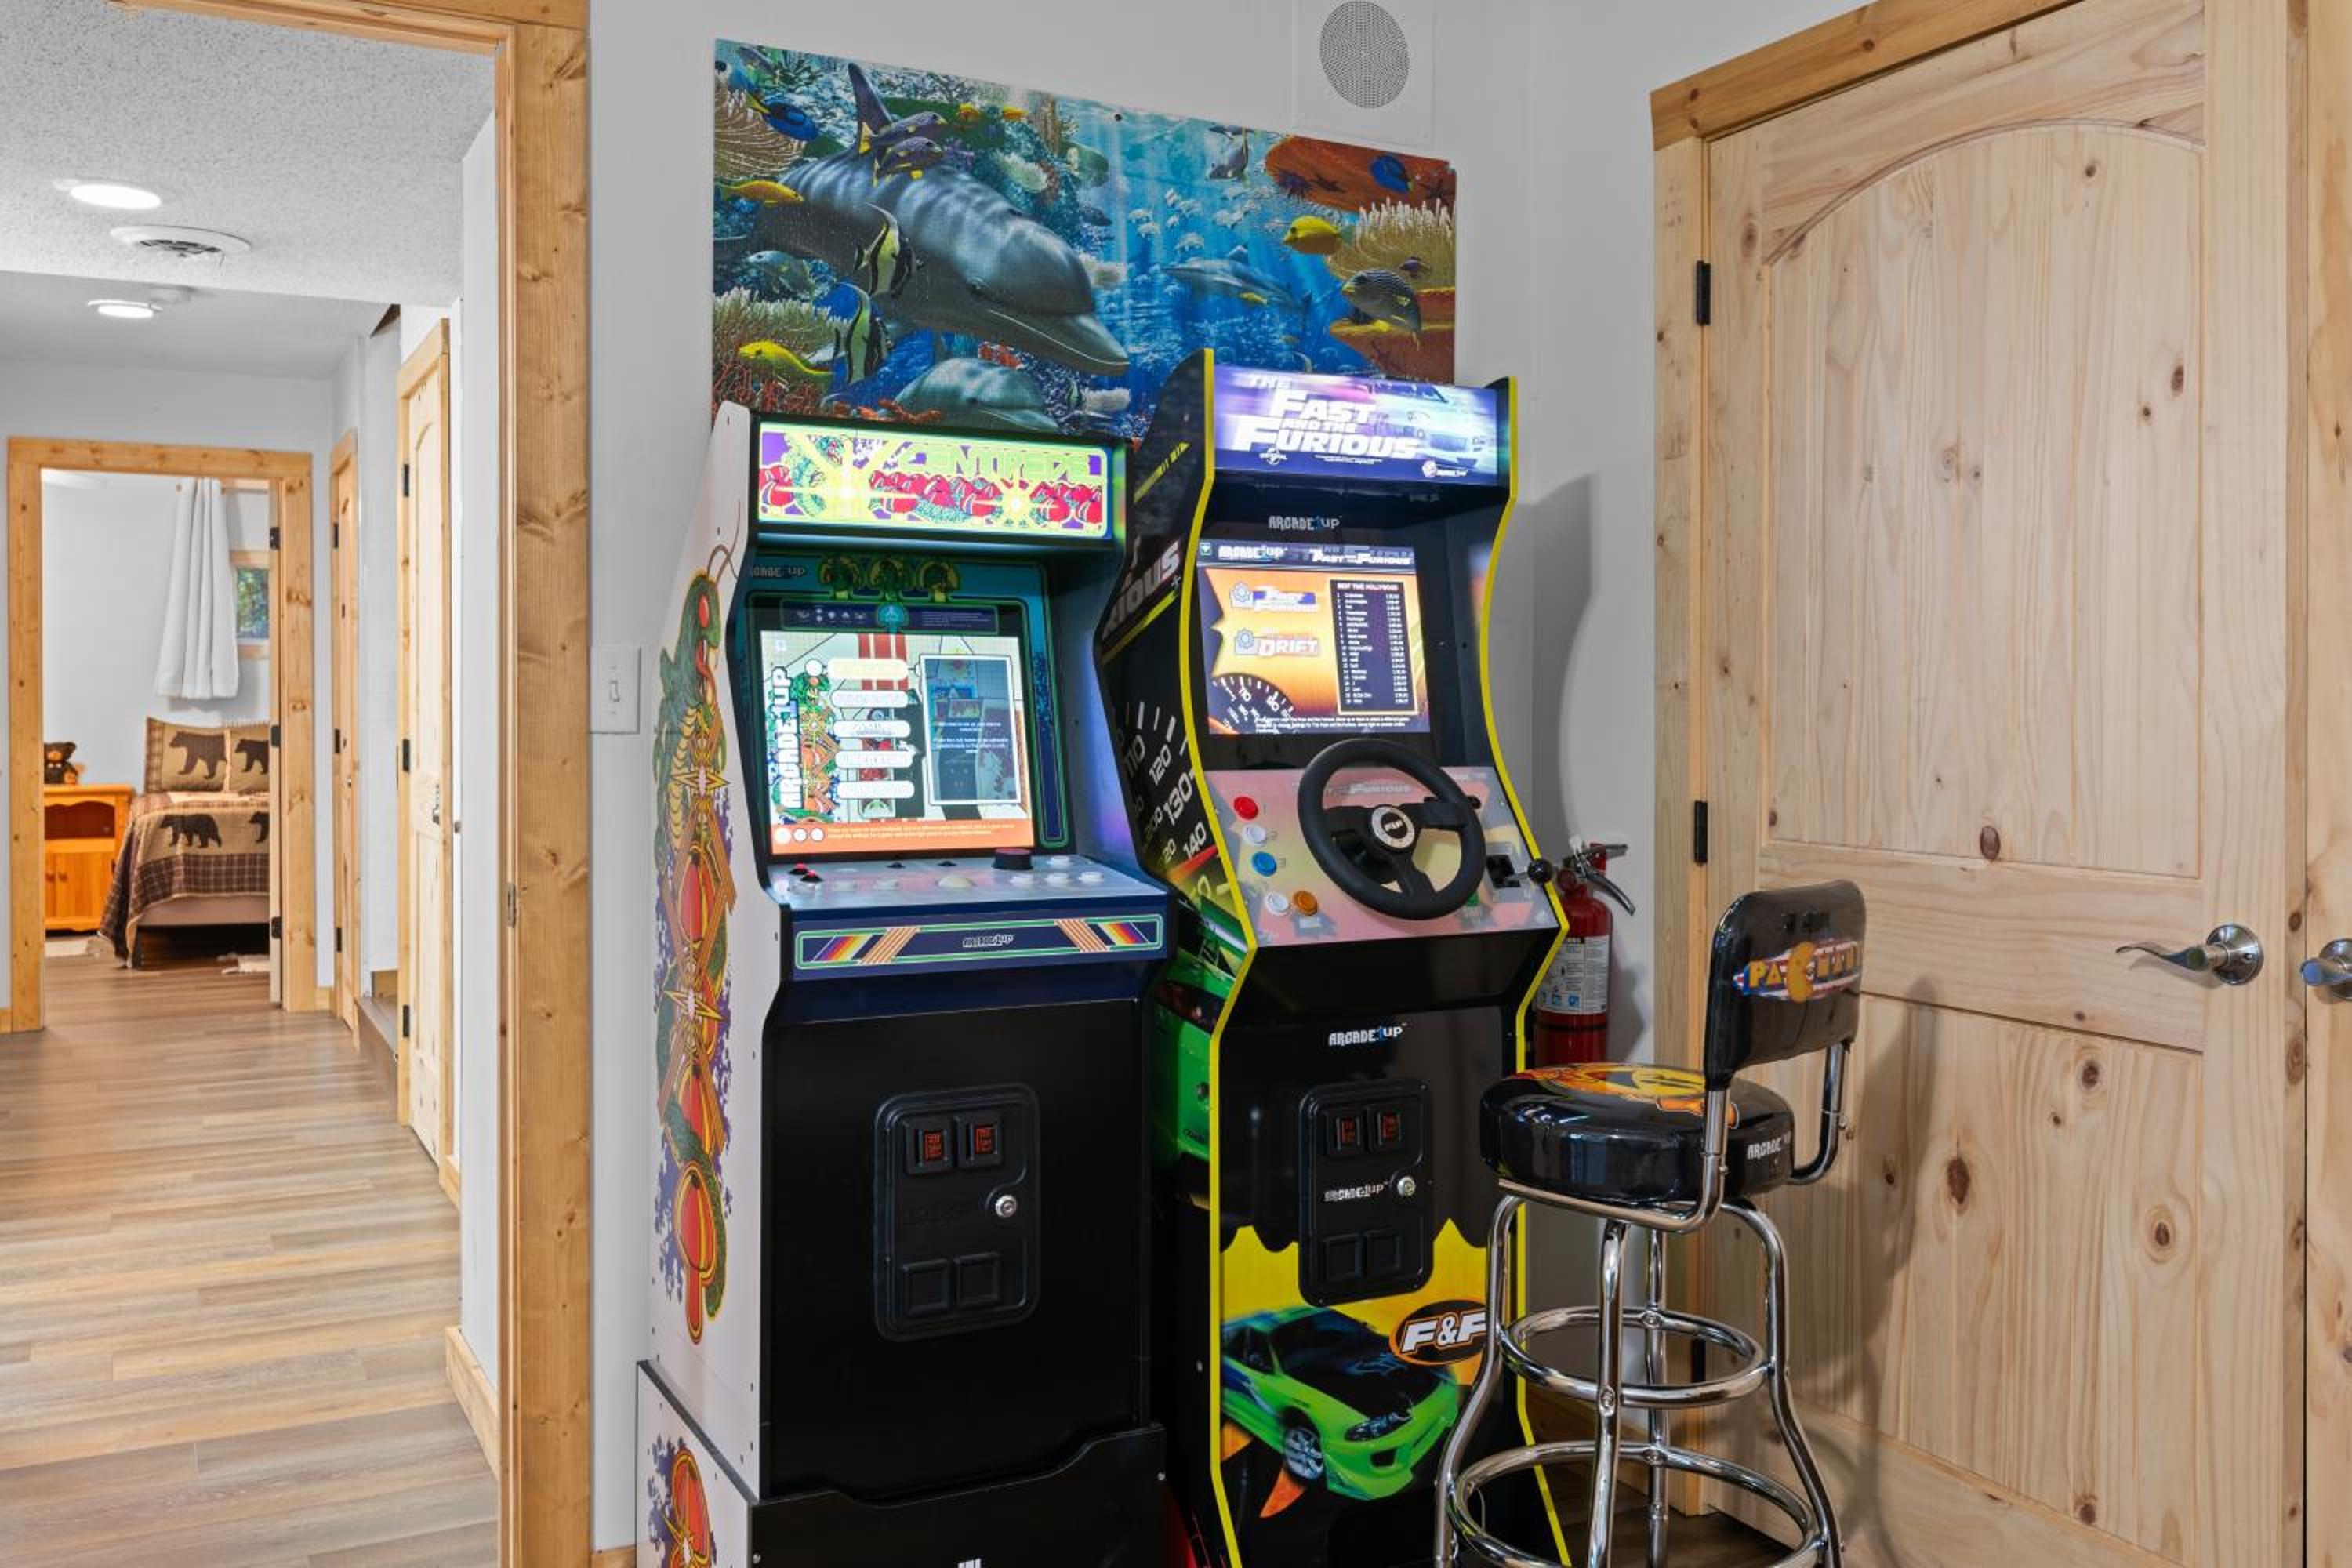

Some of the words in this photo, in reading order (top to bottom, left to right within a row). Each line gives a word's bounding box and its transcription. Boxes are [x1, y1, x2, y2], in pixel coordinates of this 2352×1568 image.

[1268, 389, 1377, 424] FAST
[1229, 413, 1418, 459] FURIOUS
[1258, 638, 1319, 656] DRIFT
[1149, 744, 1172, 786] 120
[1163, 772, 1192, 826] 130
[1183, 821, 1207, 858] 140
[1400, 1311, 1486, 1353] F&F
